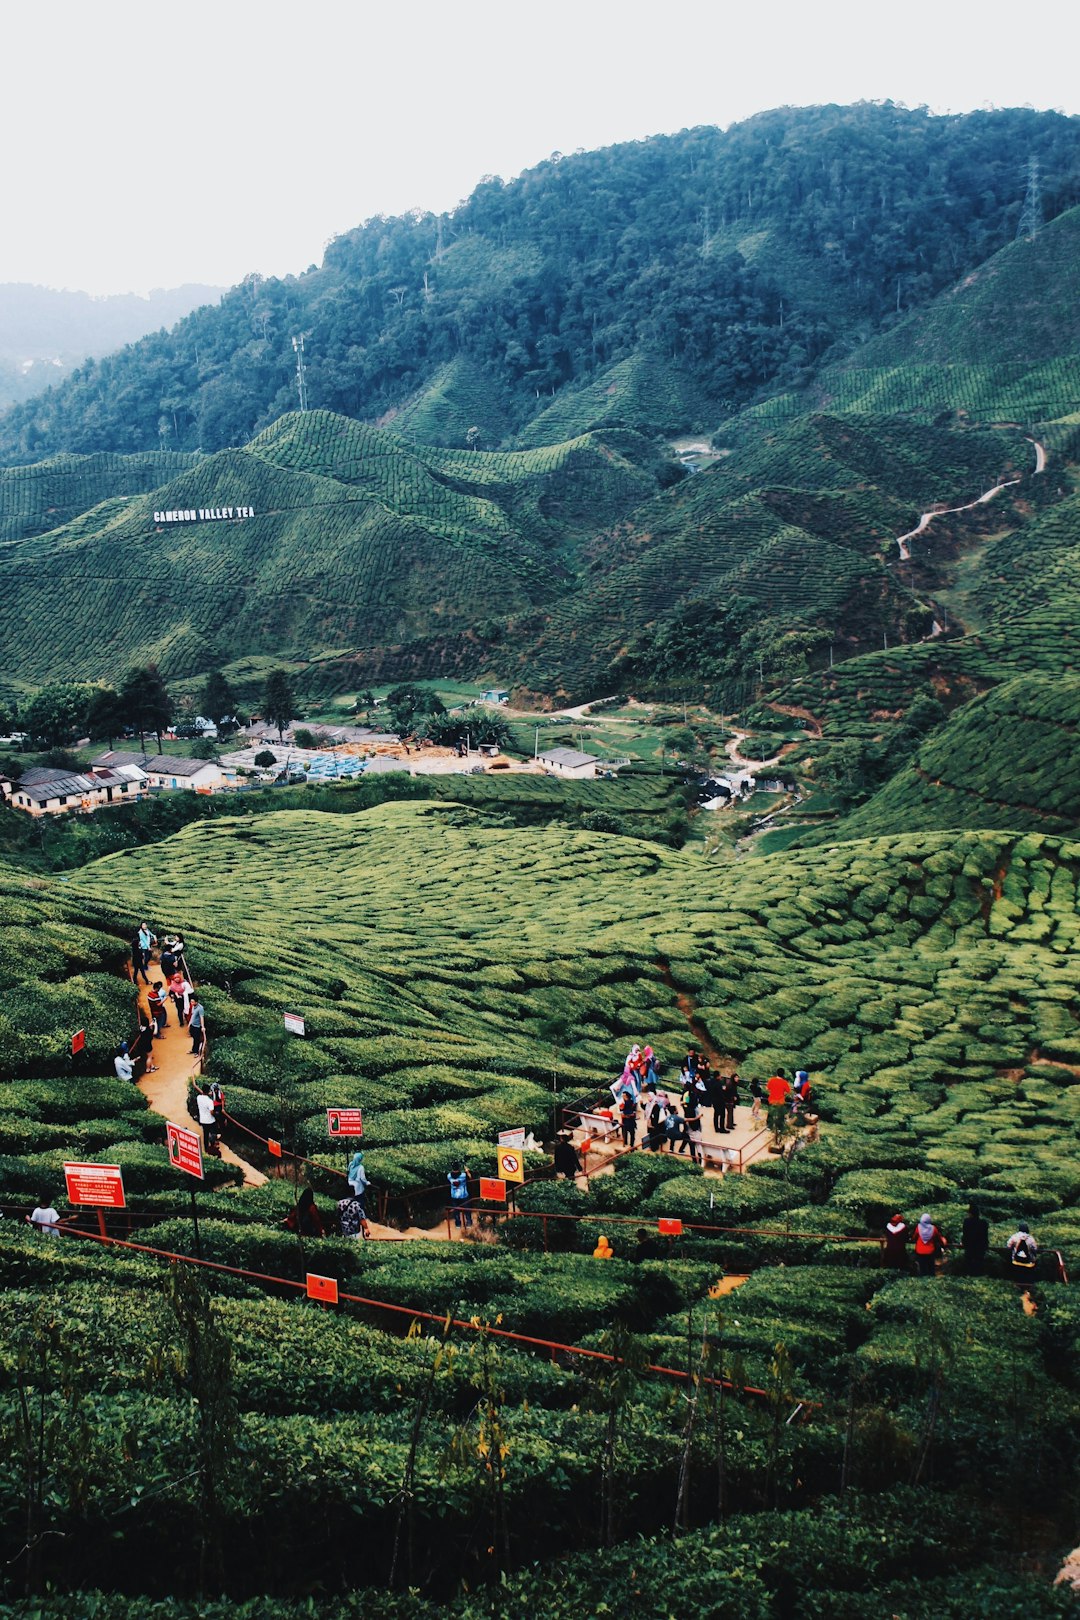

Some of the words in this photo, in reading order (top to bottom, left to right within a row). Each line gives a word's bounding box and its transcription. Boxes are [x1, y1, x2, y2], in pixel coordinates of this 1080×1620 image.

[154, 510, 196, 522] CAMERON
[199, 508, 233, 520] VALLEY
[236, 506, 255, 518] TEA
